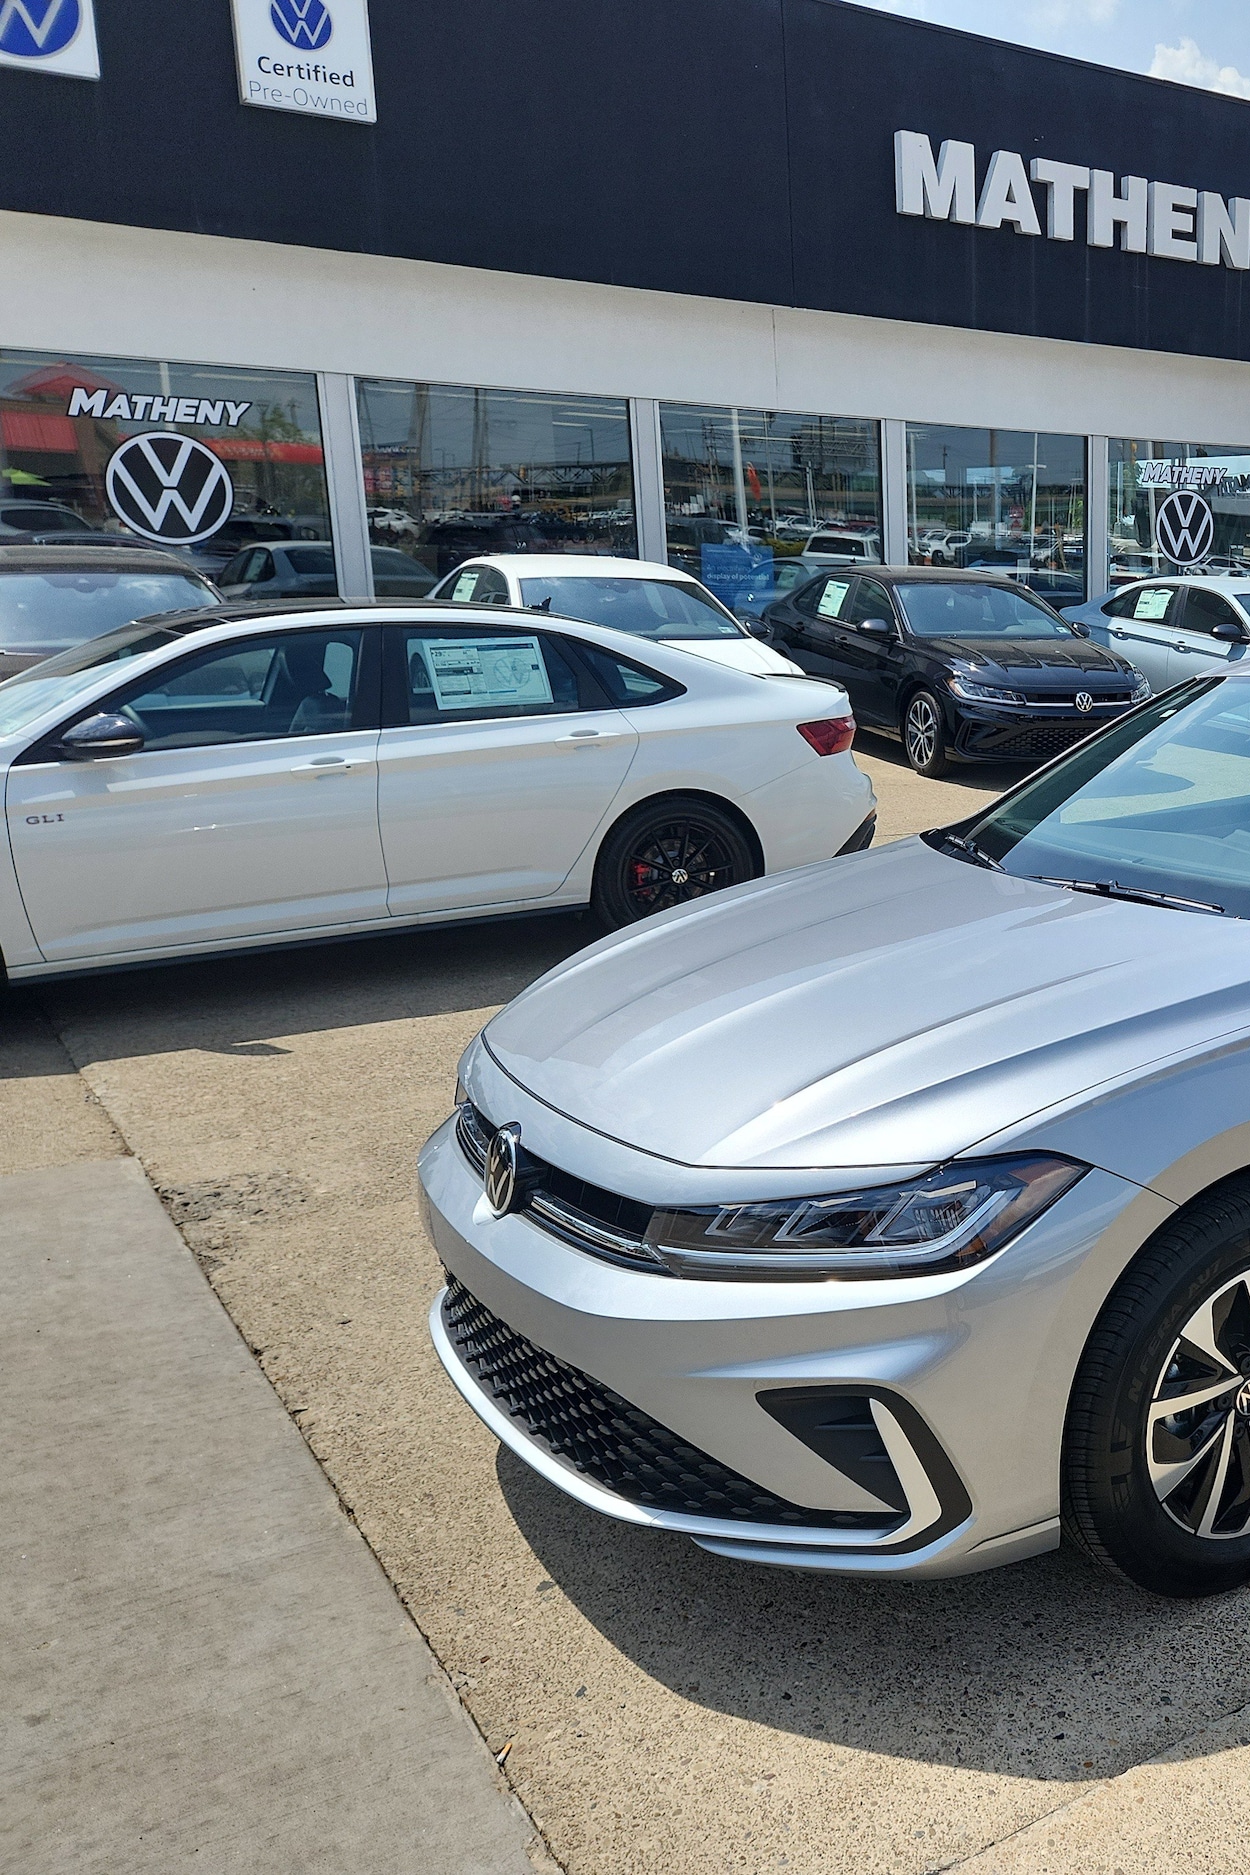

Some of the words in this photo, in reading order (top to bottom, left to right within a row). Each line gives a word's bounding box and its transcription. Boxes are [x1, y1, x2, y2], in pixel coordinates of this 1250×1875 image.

[257, 55, 355, 89] Certified
[248, 80, 369, 117] Pre-Owned
[68, 386, 253, 427] MATHENY
[1142, 461, 1228, 486] MATHENY
[25, 813, 65, 826] GLI
